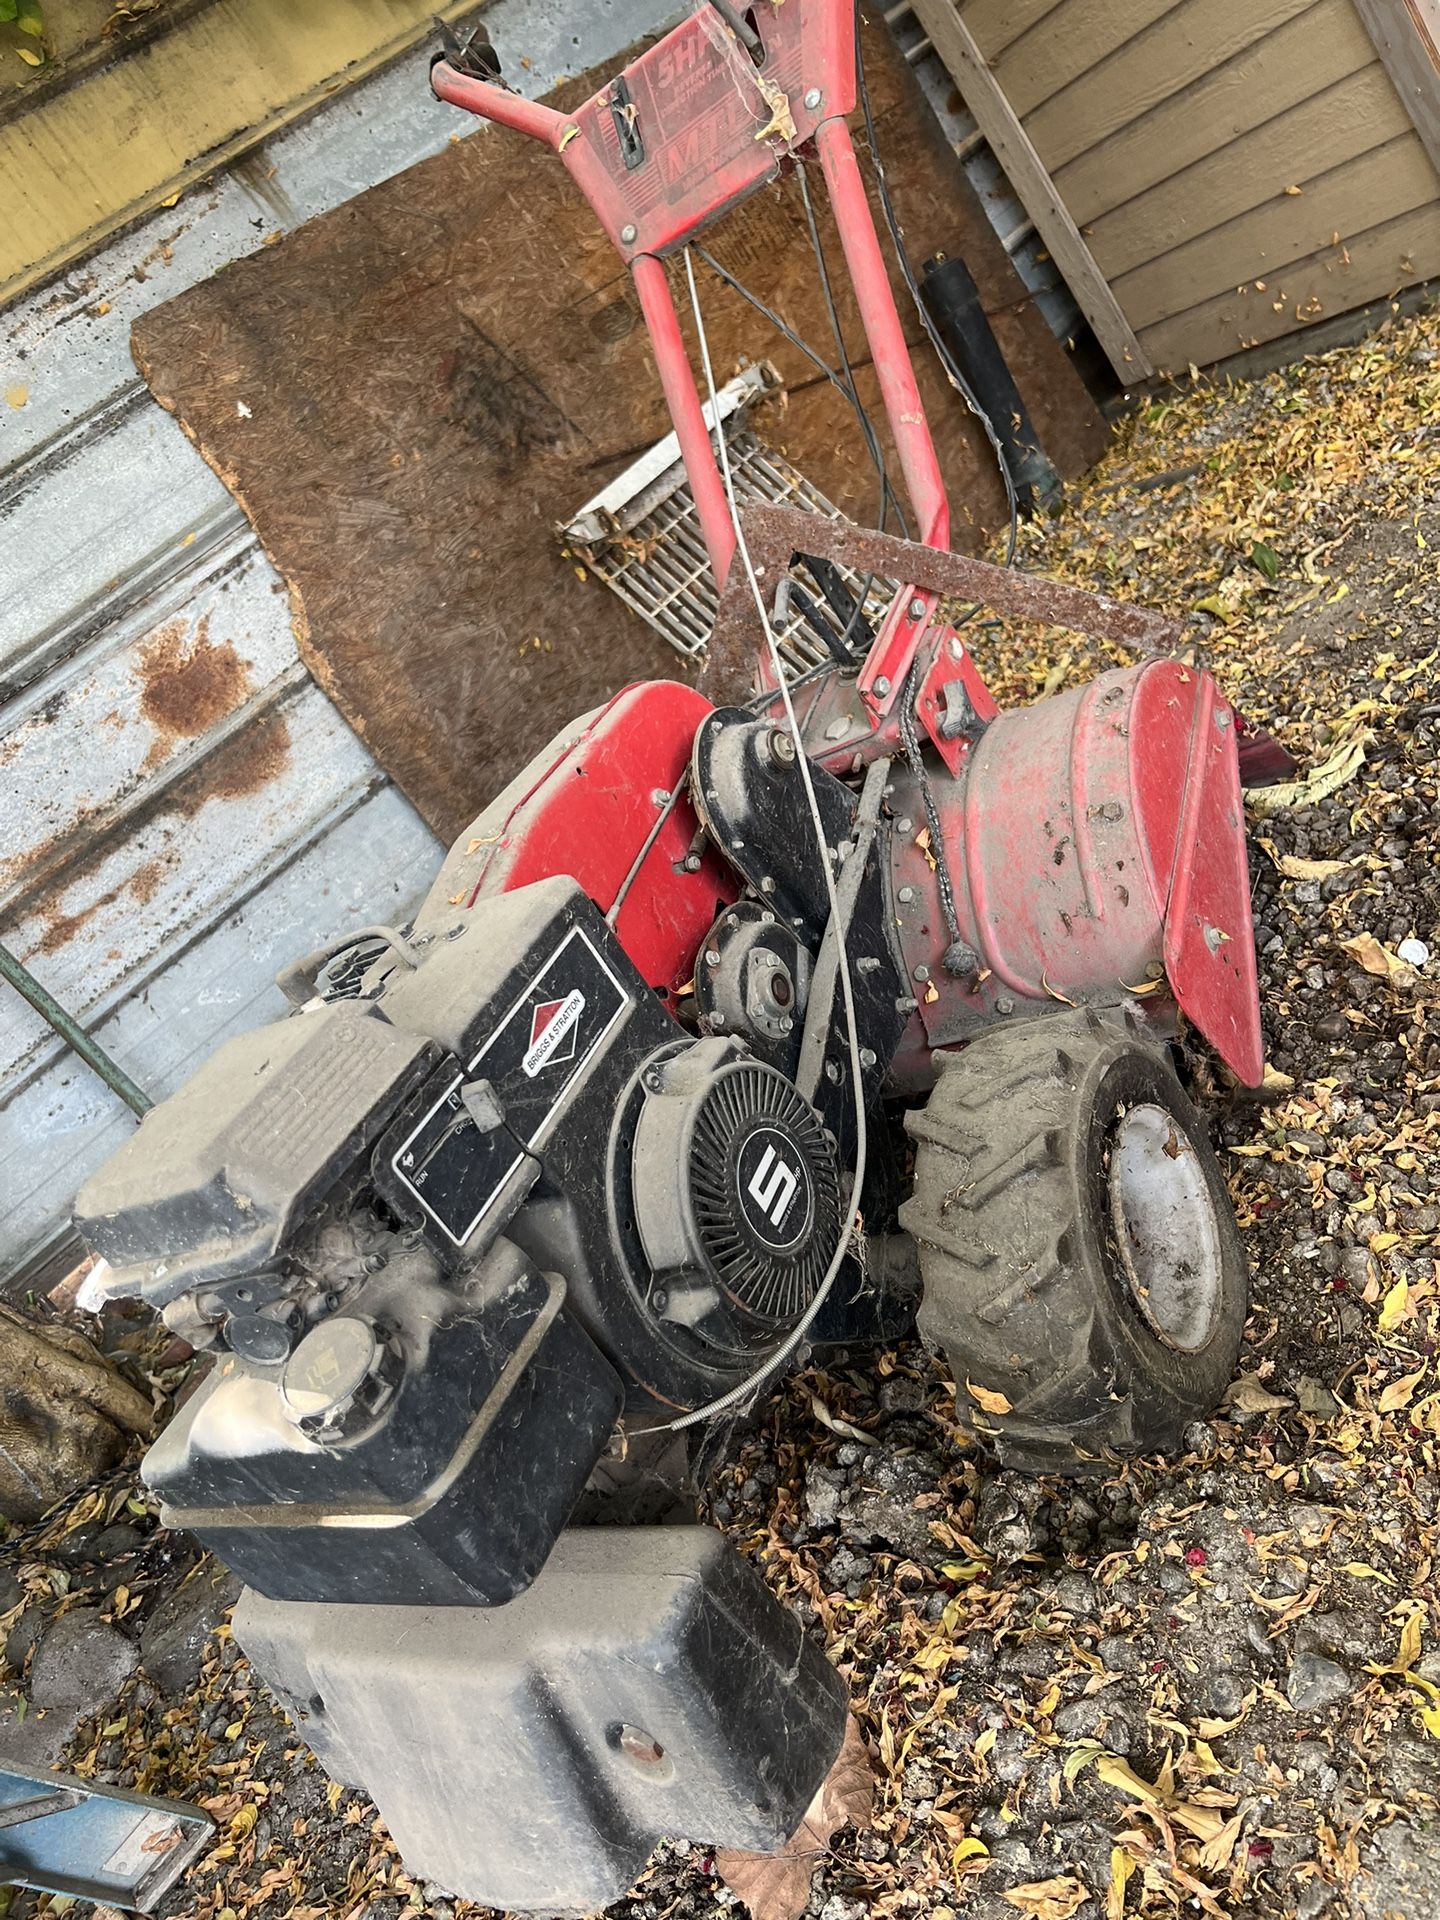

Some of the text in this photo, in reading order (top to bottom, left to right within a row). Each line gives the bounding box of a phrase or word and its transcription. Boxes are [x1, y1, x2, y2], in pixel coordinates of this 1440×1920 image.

[527, 1038, 551, 1070] BRIGGS
[548, 1032, 555, 1042] &
[552, 996, 581, 1035] STRATTON
[415, 1170, 429, 1188] RUN
[748, 1144, 802, 1226] 5 HP
